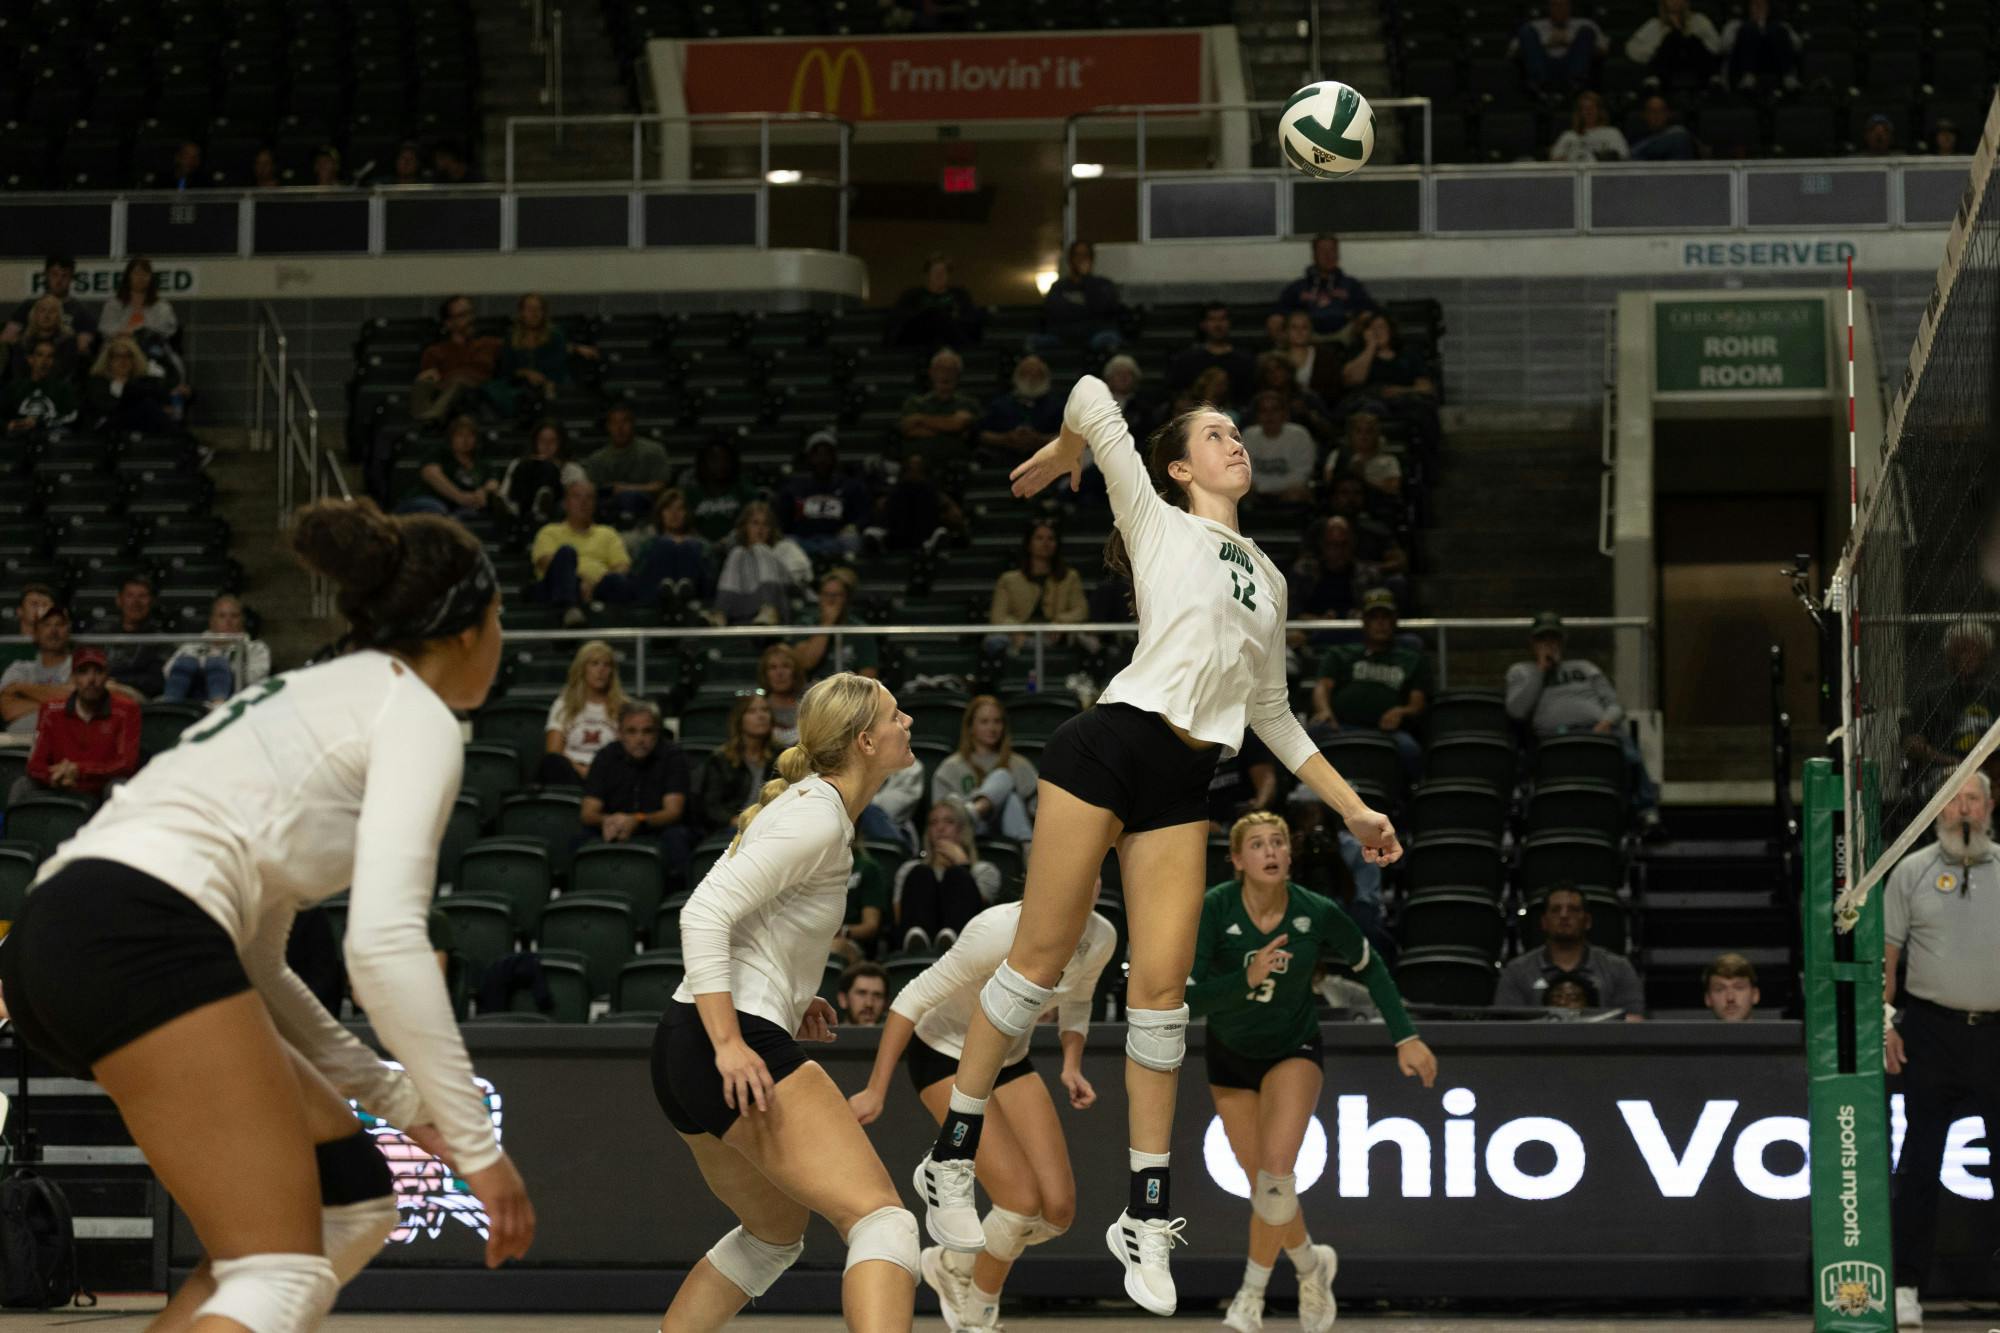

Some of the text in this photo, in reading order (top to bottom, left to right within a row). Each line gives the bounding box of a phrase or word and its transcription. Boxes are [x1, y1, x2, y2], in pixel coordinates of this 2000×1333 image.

[1055, 57, 1084, 89] it
[1685, 241, 1857, 265] RESERVED
[1703, 336, 1778, 357] ROHR
[1700, 365, 1783, 386] ROOM
[1230, 570, 1256, 612] 12
[1203, 1087, 1586, 1200] Ohio
[1836, 1104, 1862, 1248] sports imports
